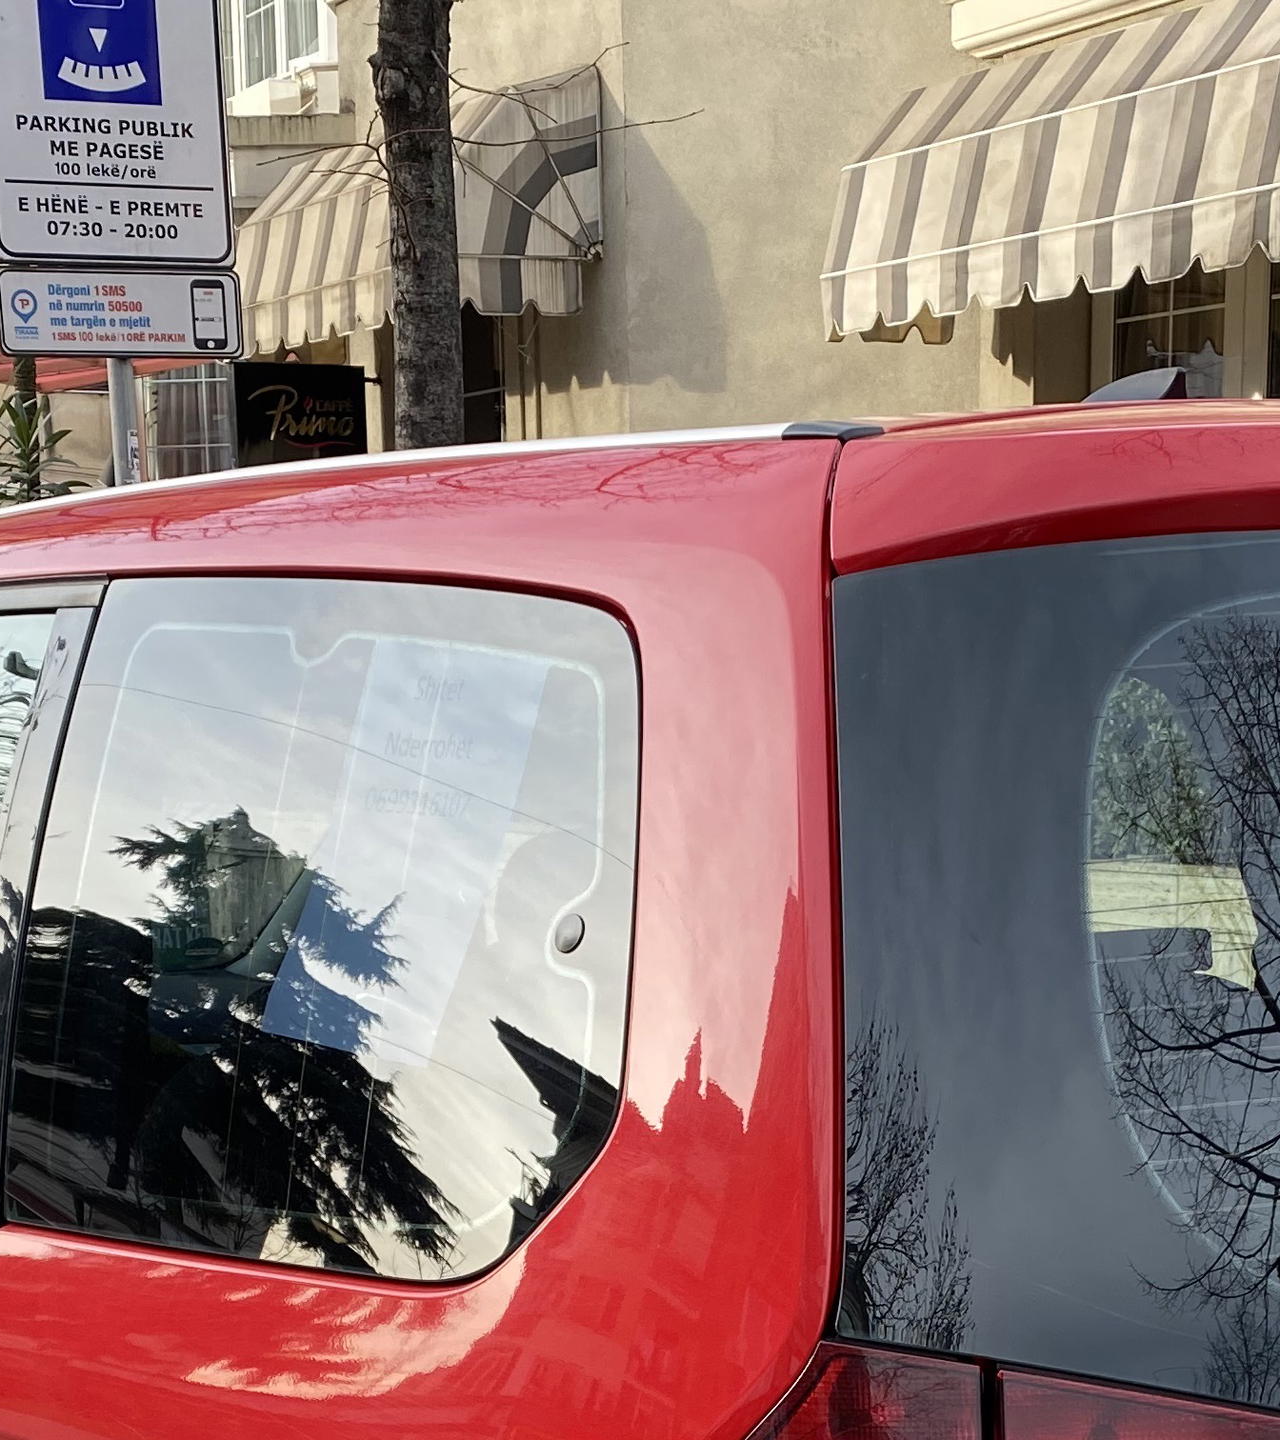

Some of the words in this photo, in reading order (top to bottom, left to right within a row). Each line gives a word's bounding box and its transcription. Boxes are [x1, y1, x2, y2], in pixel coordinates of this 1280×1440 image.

[15, 114, 112, 135] PARKING
[118, 120, 195, 139] PUBLIK
[50, 140, 79, 156] ME
[86, 141, 165, 161] PAGESË
[54, 162, 81, 176] 100
[87, 163, 156, 179] lekë/orë
[18, 197, 29, 212] E
[36, 194, 89, 214] HËNË
[110, 200, 121, 215] E
[127, 201, 204, 218] PREMTE
[47, 220, 103, 237] 07:30
[124, 223, 178, 239] 20:00
[48, 284, 90, 298] Dërgoni
[49, 299, 62, 311] në
[66, 301, 105, 312] numrin
[108, 301, 143, 312] 50500
[50, 317, 68, 327] me
[70, 316, 107, 329] targën
[109, 318, 116, 327] e
[118, 316, 151, 330] mjetit
[148, 333, 186, 343] PARKIM
[247, 384, 356, 441] Primo
